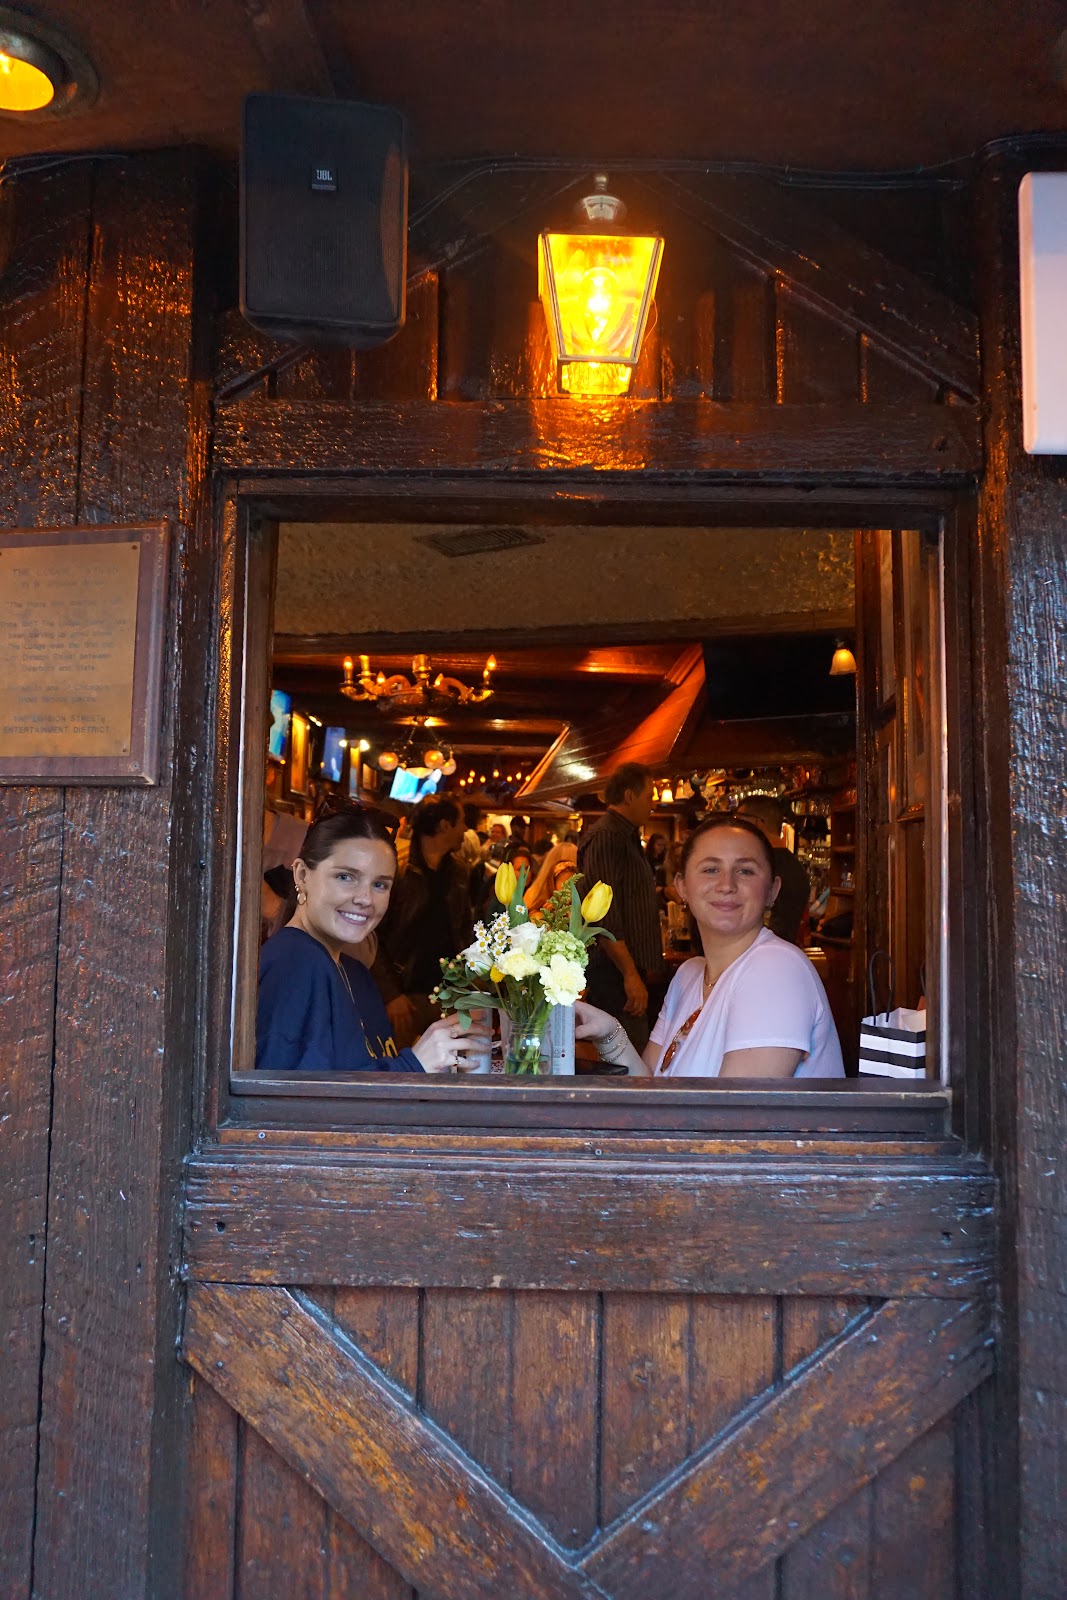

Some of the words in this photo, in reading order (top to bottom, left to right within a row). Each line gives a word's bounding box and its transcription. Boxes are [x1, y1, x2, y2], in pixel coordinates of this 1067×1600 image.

[316, 169, 333, 181] JBL
[3, 726, 68, 734] ENTERTAINMENT
[73, 726, 110, 734] DISTRICT
